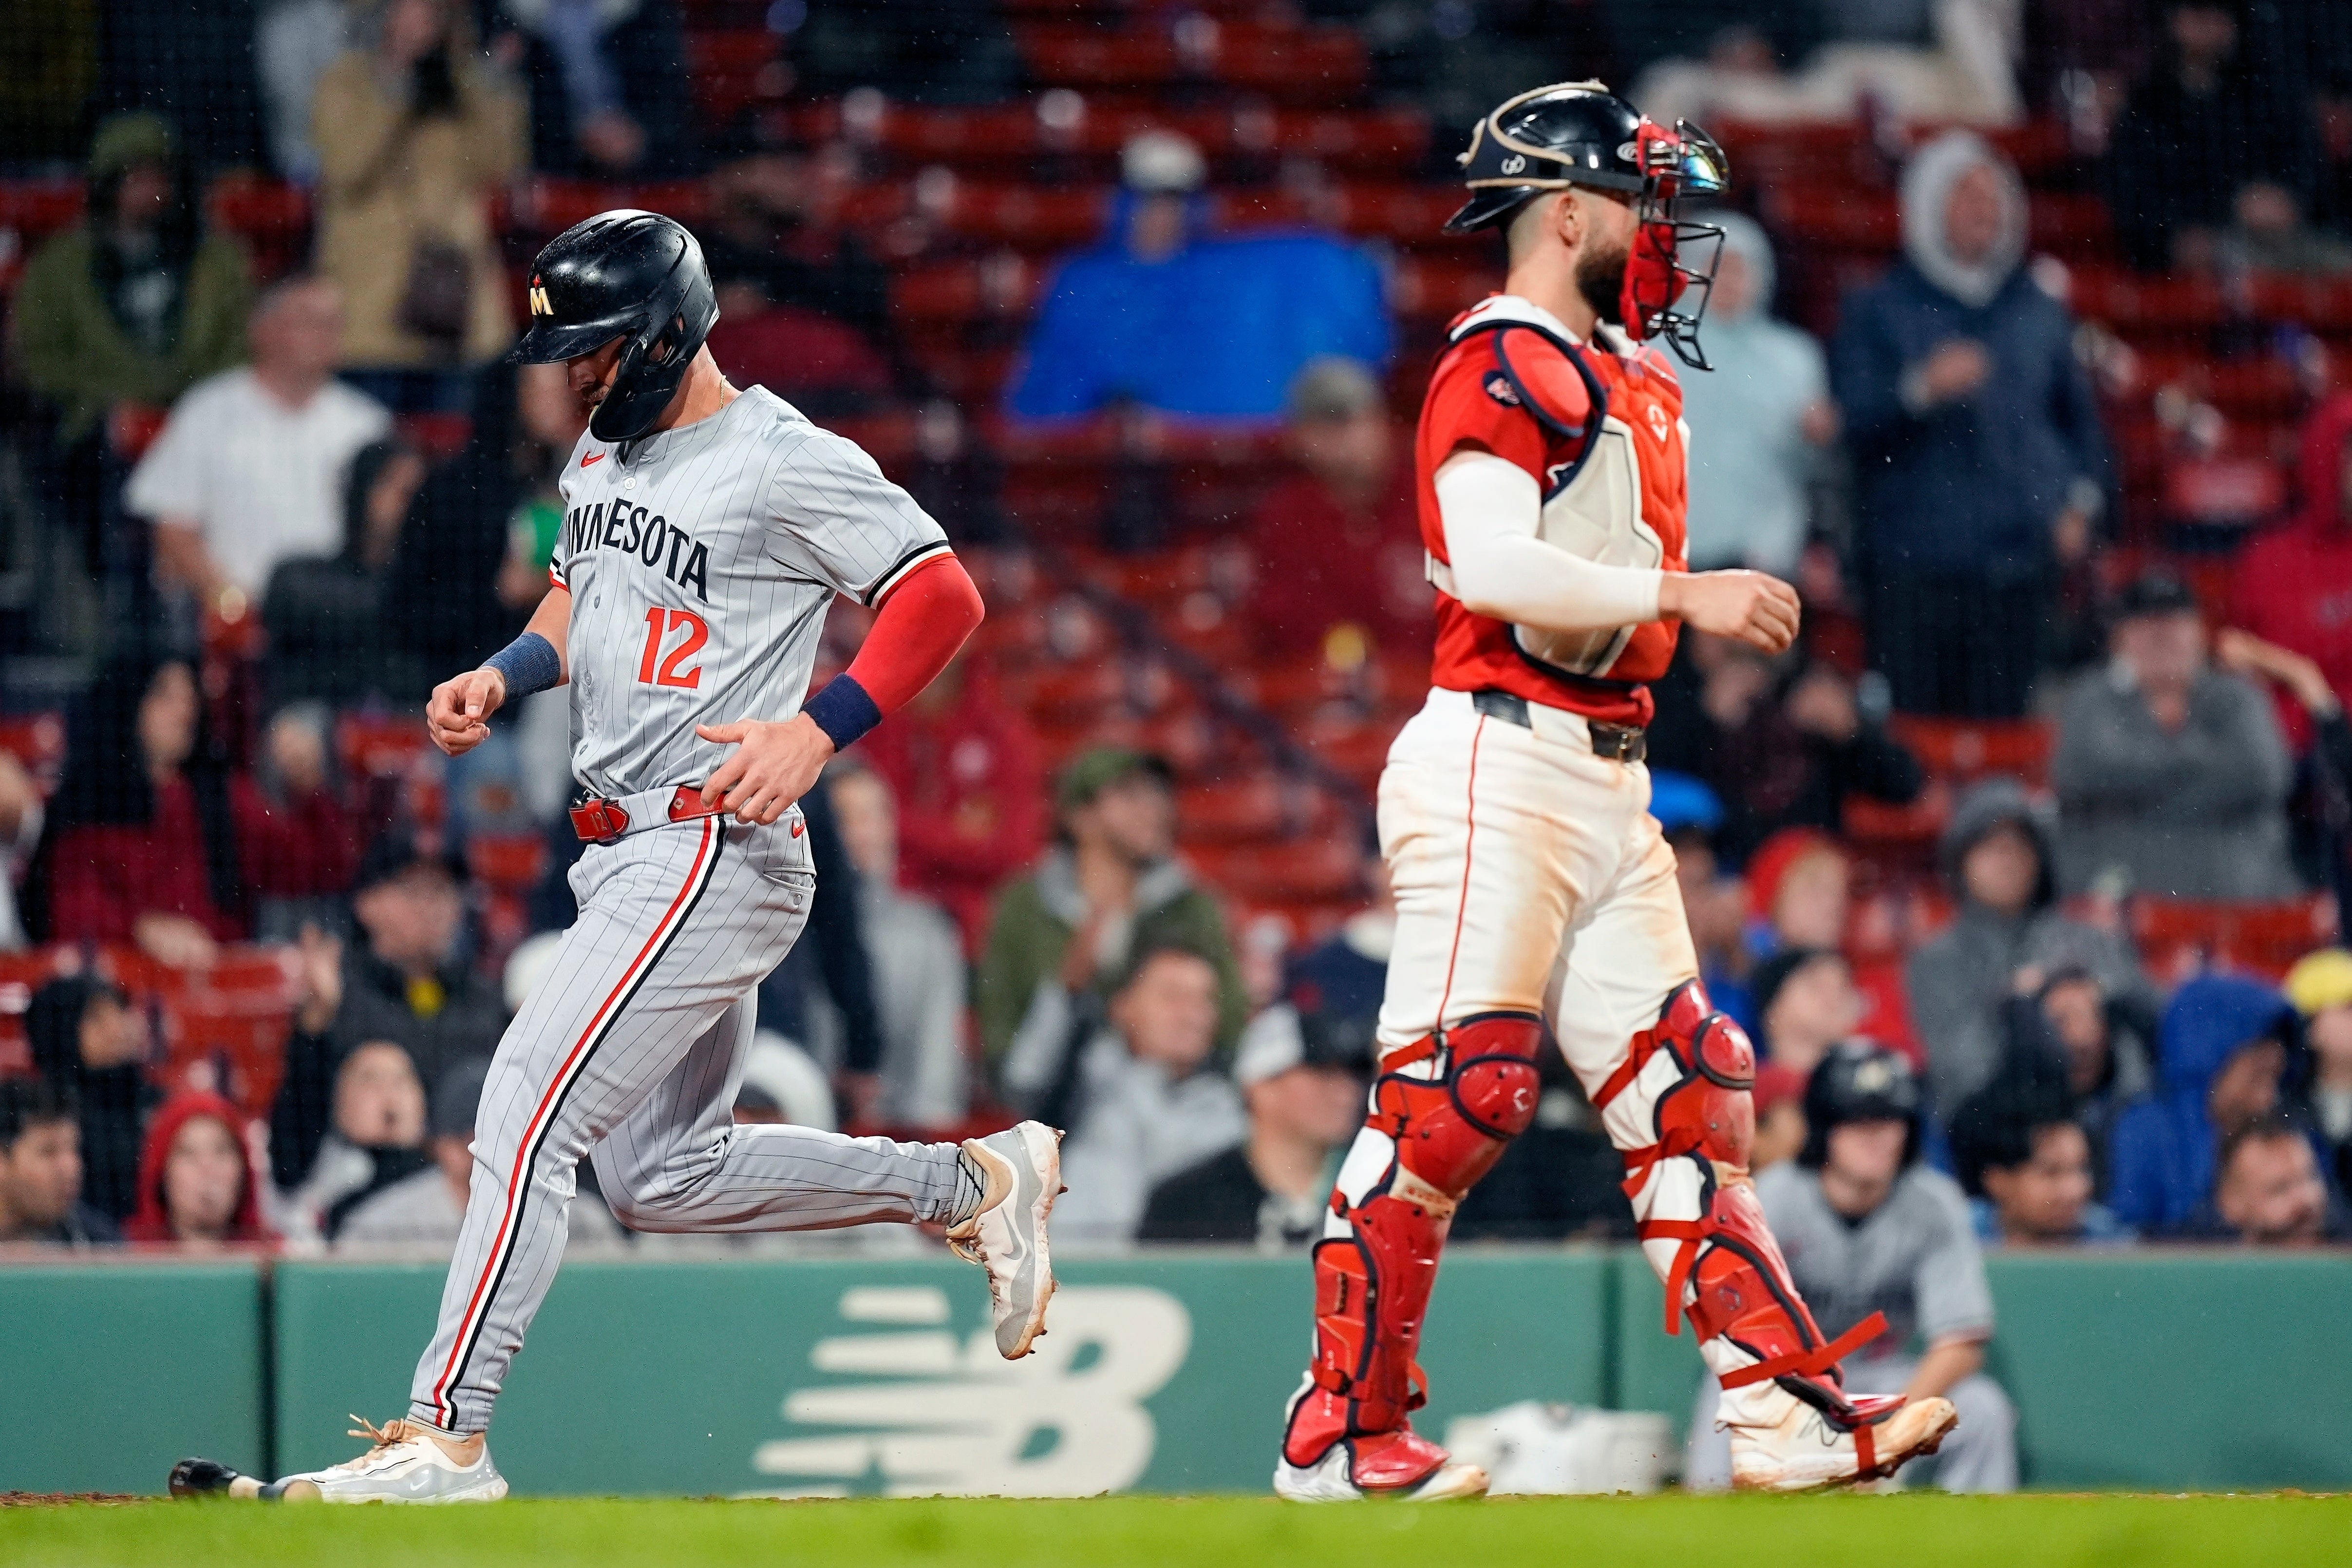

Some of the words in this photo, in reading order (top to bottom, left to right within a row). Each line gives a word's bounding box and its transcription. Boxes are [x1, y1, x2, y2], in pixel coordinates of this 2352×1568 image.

[530, 287, 554, 316] M
[566, 497, 708, 604] INNESOTA
[638, 607, 708, 689] 12
[590, 812, 607, 832] 12
